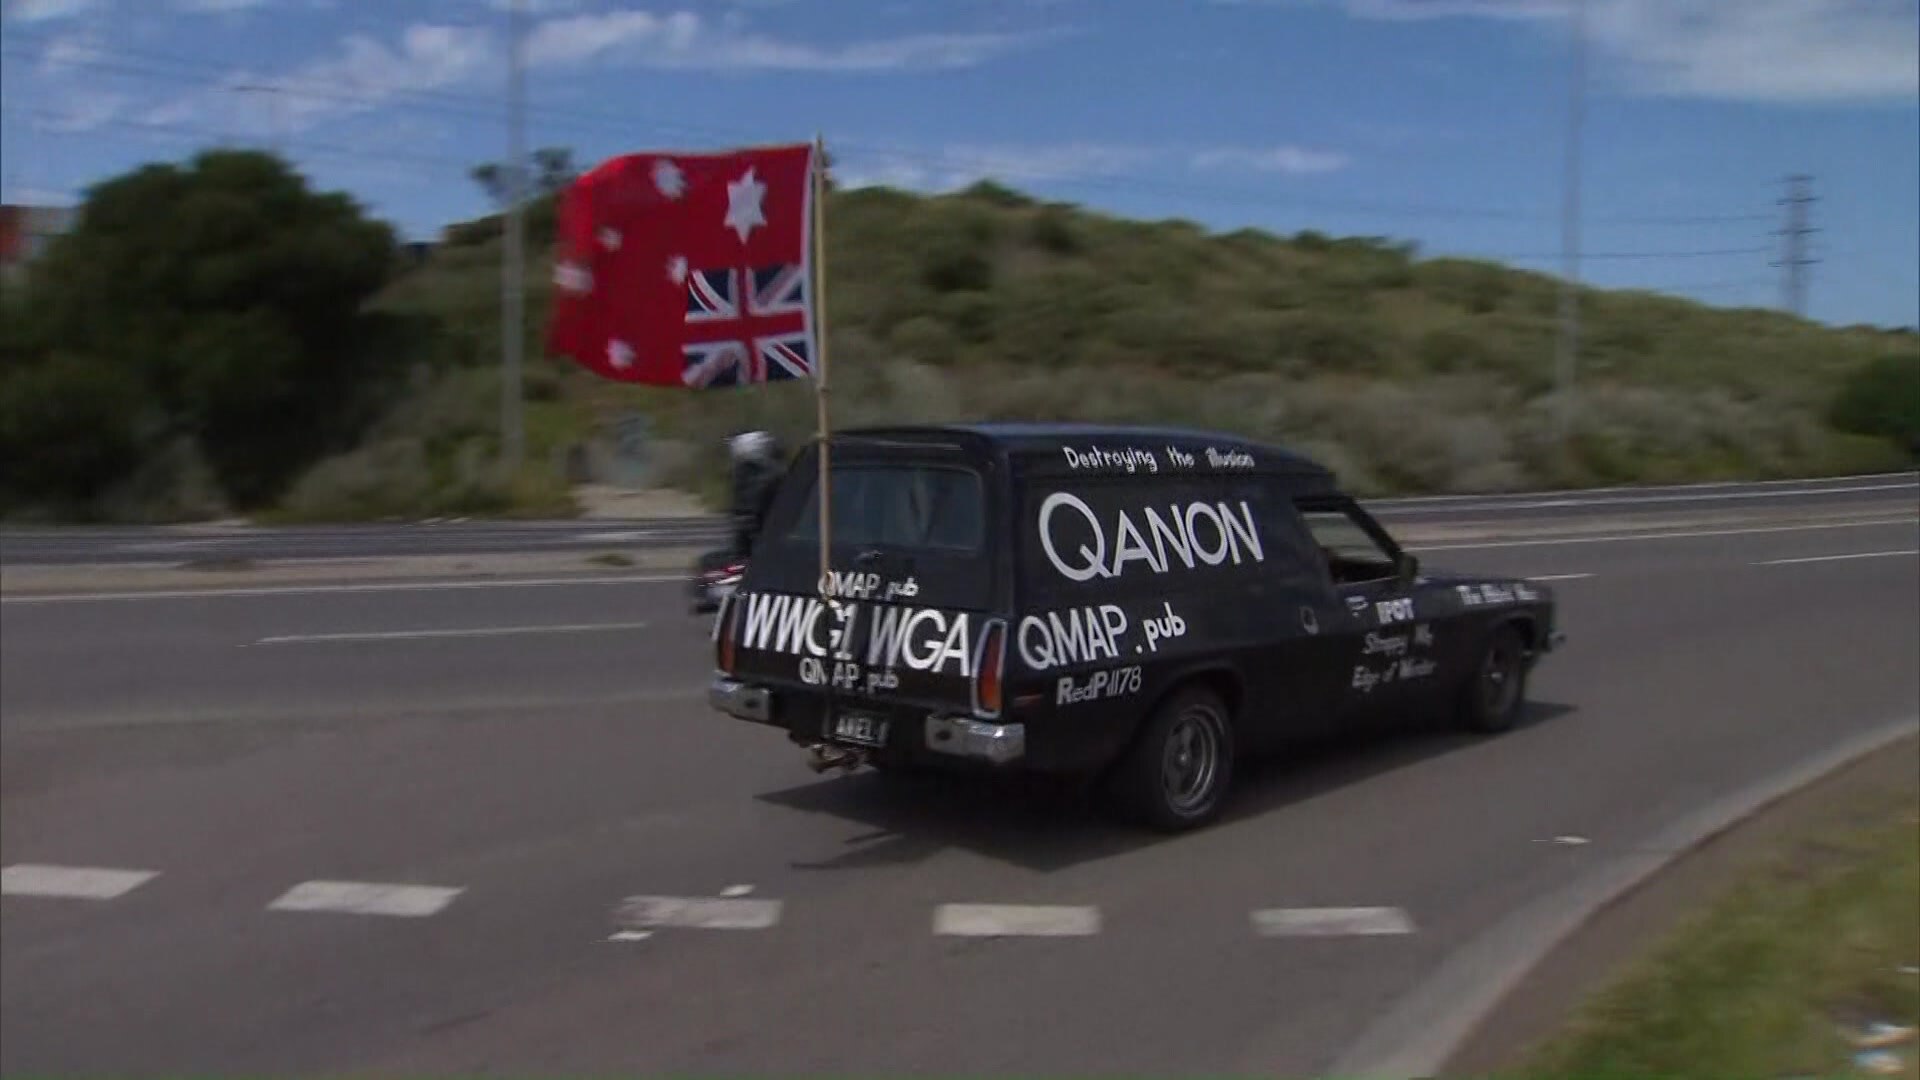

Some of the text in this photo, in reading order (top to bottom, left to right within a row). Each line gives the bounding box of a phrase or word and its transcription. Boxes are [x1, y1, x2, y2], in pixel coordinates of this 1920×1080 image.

[1062, 445, 1158, 473] Destroying
[1166, 445, 1195, 468] the
[1038, 492, 1265, 582] QANON
[866, 603, 971, 677] WGA
